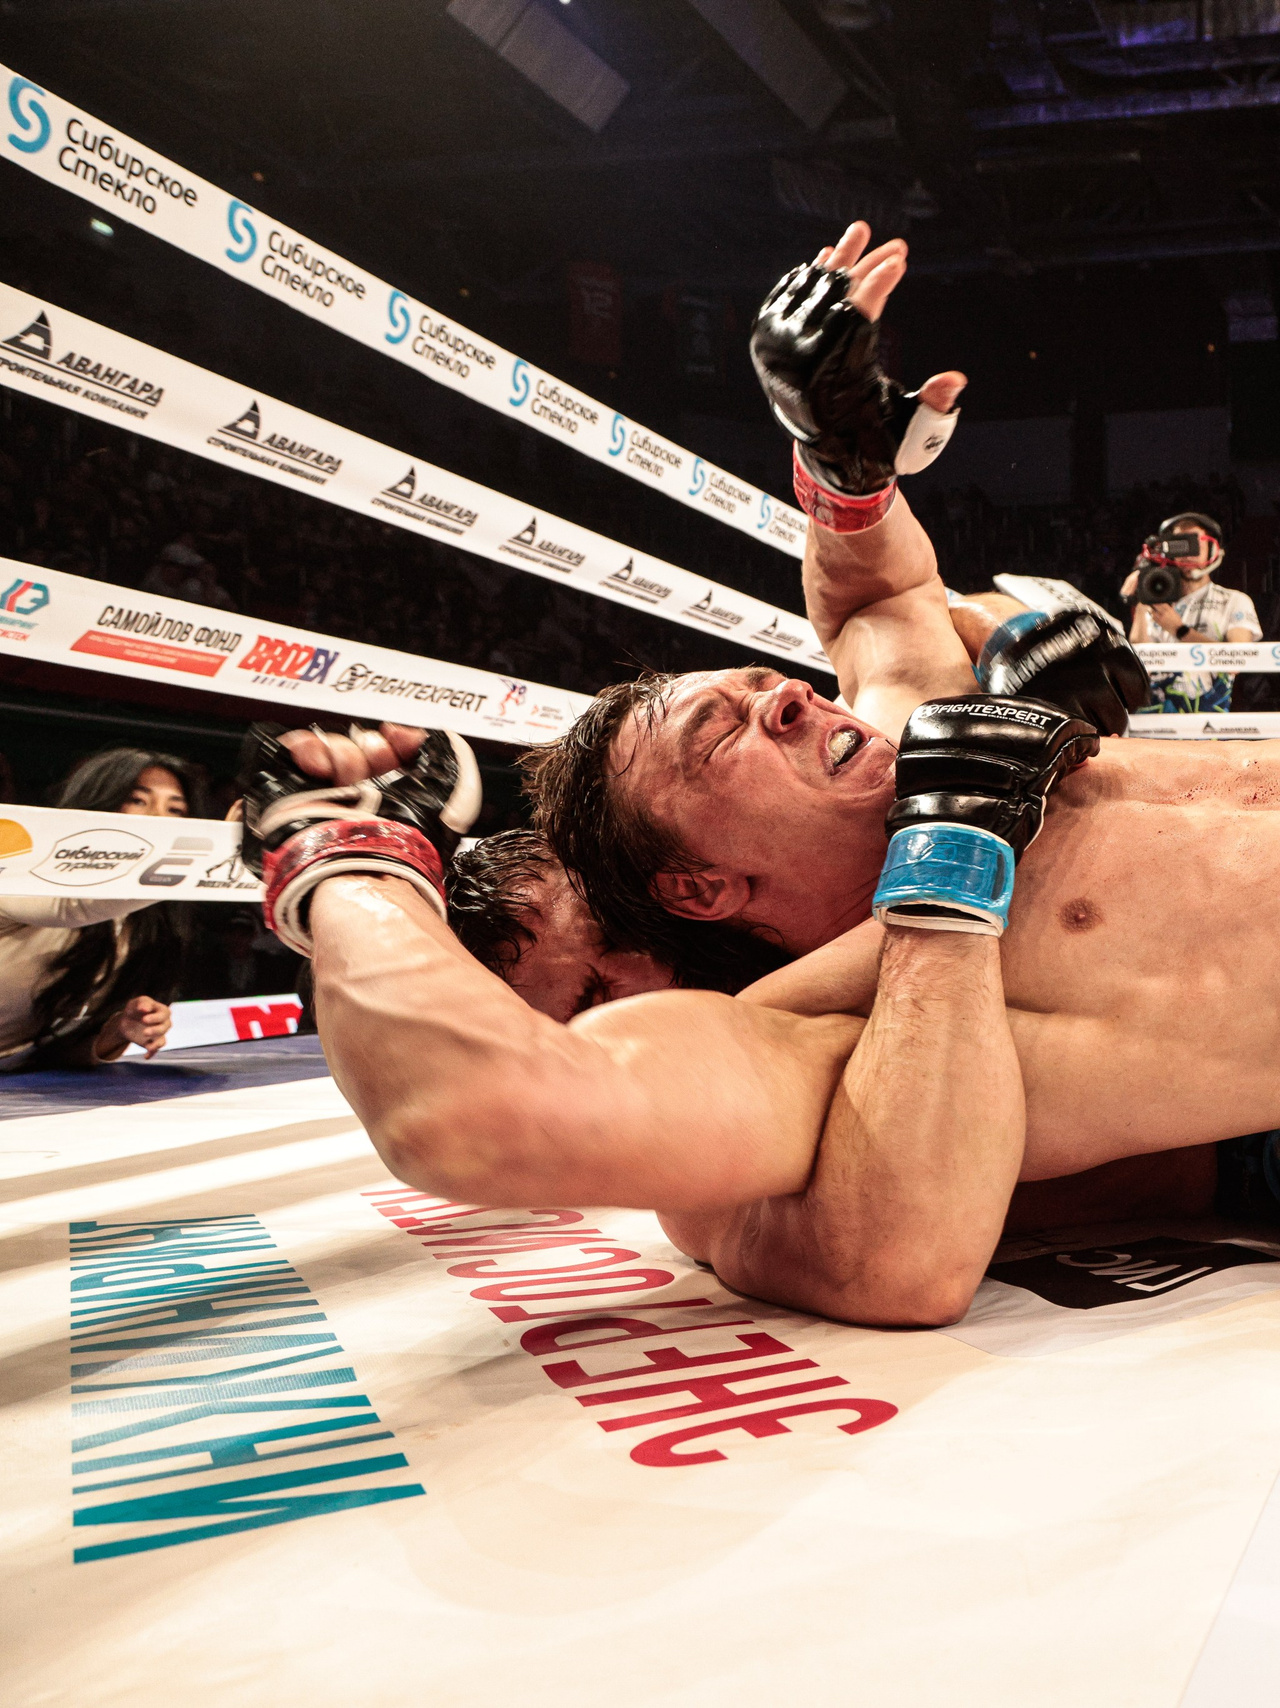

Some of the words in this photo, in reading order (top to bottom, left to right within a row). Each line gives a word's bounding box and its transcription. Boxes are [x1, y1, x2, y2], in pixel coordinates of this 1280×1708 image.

[58, 147, 157, 214] Стекло
[66, 119, 199, 207] Сибирское
[260, 255, 334, 307] Стекло
[269, 231, 366, 300] Сибирское
[412, 336, 470, 379] Стекло
[419, 315, 496, 369] Сибирское
[57, 352, 165, 407] АВАНГАРД
[536, 379, 599, 424] Сибирское
[531, 398, 578, 434] Стекло
[262, 432, 343, 475] АВАНГАРД
[97, 605, 193, 643] САМОЙЛОВ
[194, 627, 242, 652] ФОНД
[237, 635, 339, 685] BROZEX
[362, 671, 487, 713] FIGHTEXPERT
[938, 704, 1051, 726] FIGHTEXPERT
[55, 845, 145, 861] сибирский
[69, 1213, 427, 1564] ИНЖИНИРИНГ
